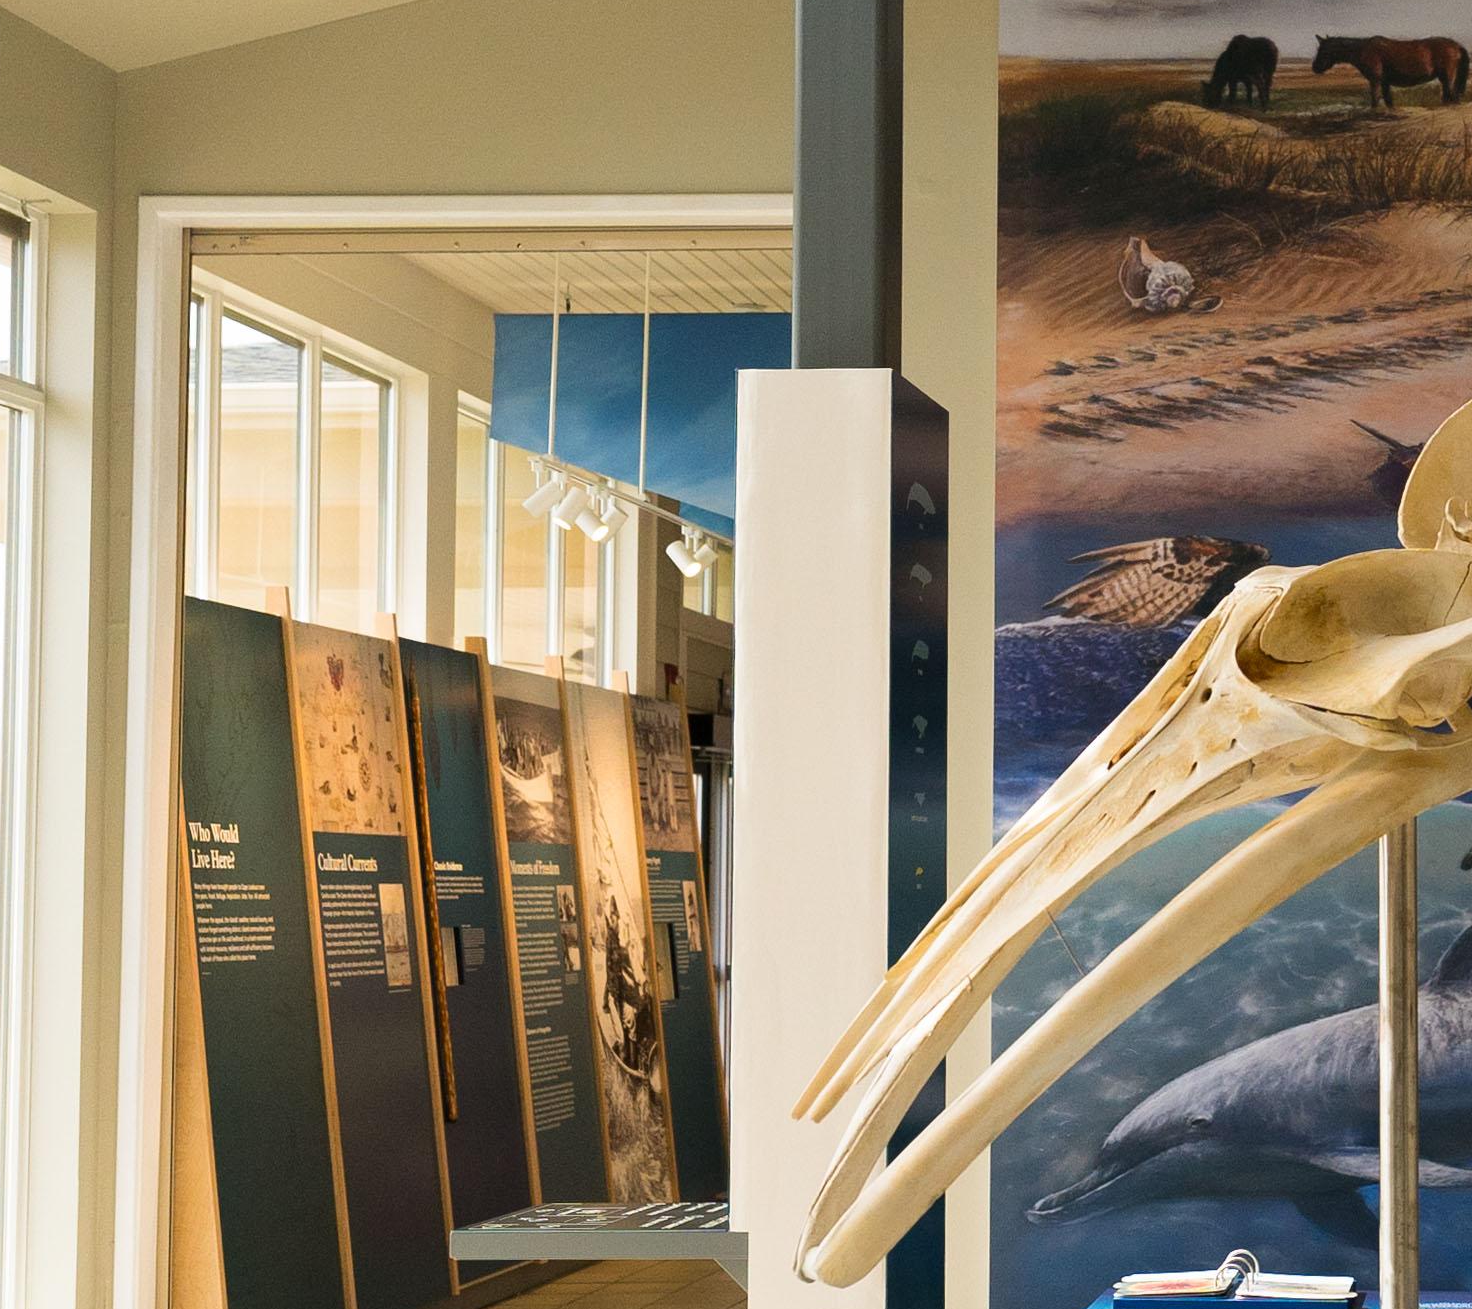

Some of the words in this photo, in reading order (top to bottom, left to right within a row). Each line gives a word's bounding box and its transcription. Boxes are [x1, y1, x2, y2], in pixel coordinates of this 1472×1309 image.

[188, 822, 211, 842] Who
[210, 823, 240, 844] Would
[191, 848, 210, 868] Live
[210, 849, 236, 870] Here?
